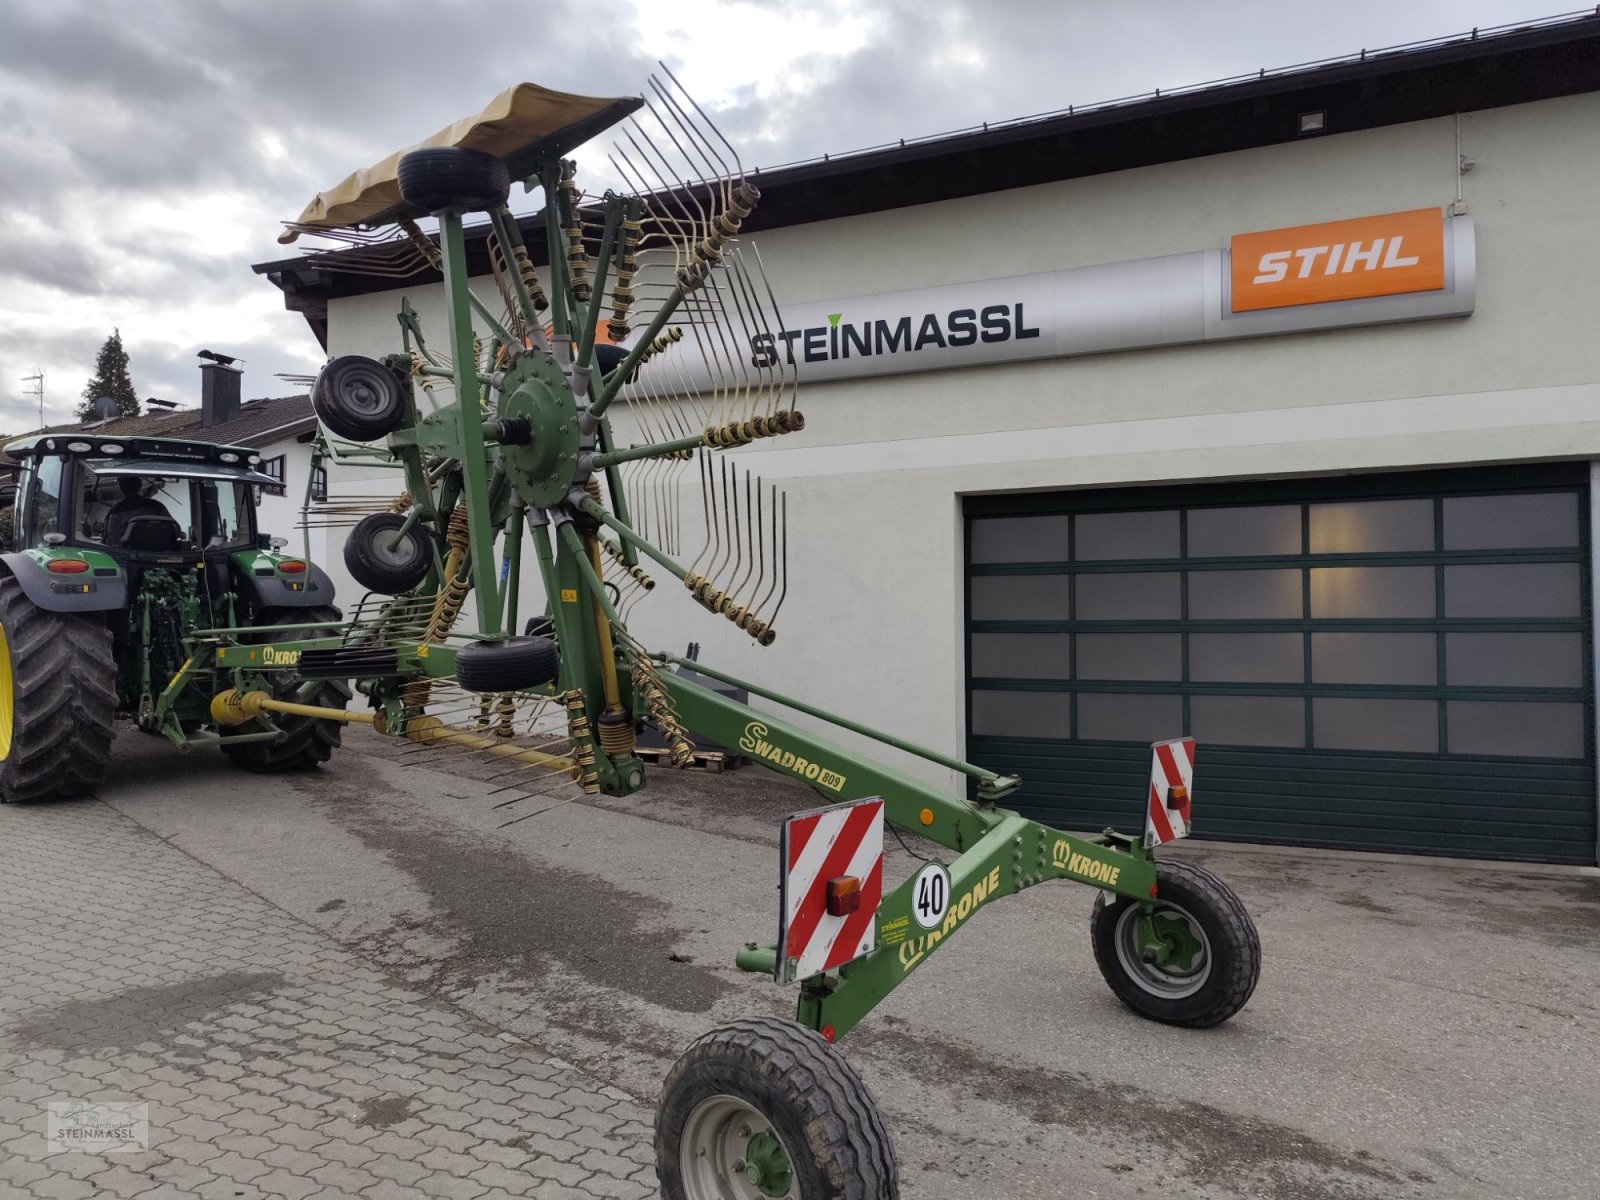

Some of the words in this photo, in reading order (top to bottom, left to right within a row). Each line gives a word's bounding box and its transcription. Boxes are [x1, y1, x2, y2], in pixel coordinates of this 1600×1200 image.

[1252, 235, 1420, 285] STIHL
[751, 303, 1040, 368] STEINMASSL
[739, 721, 820, 779] SWADRO
[822, 771, 841, 788] 809
[1068, 852, 1121, 886] KRONE
[918, 873, 944, 918] 40
